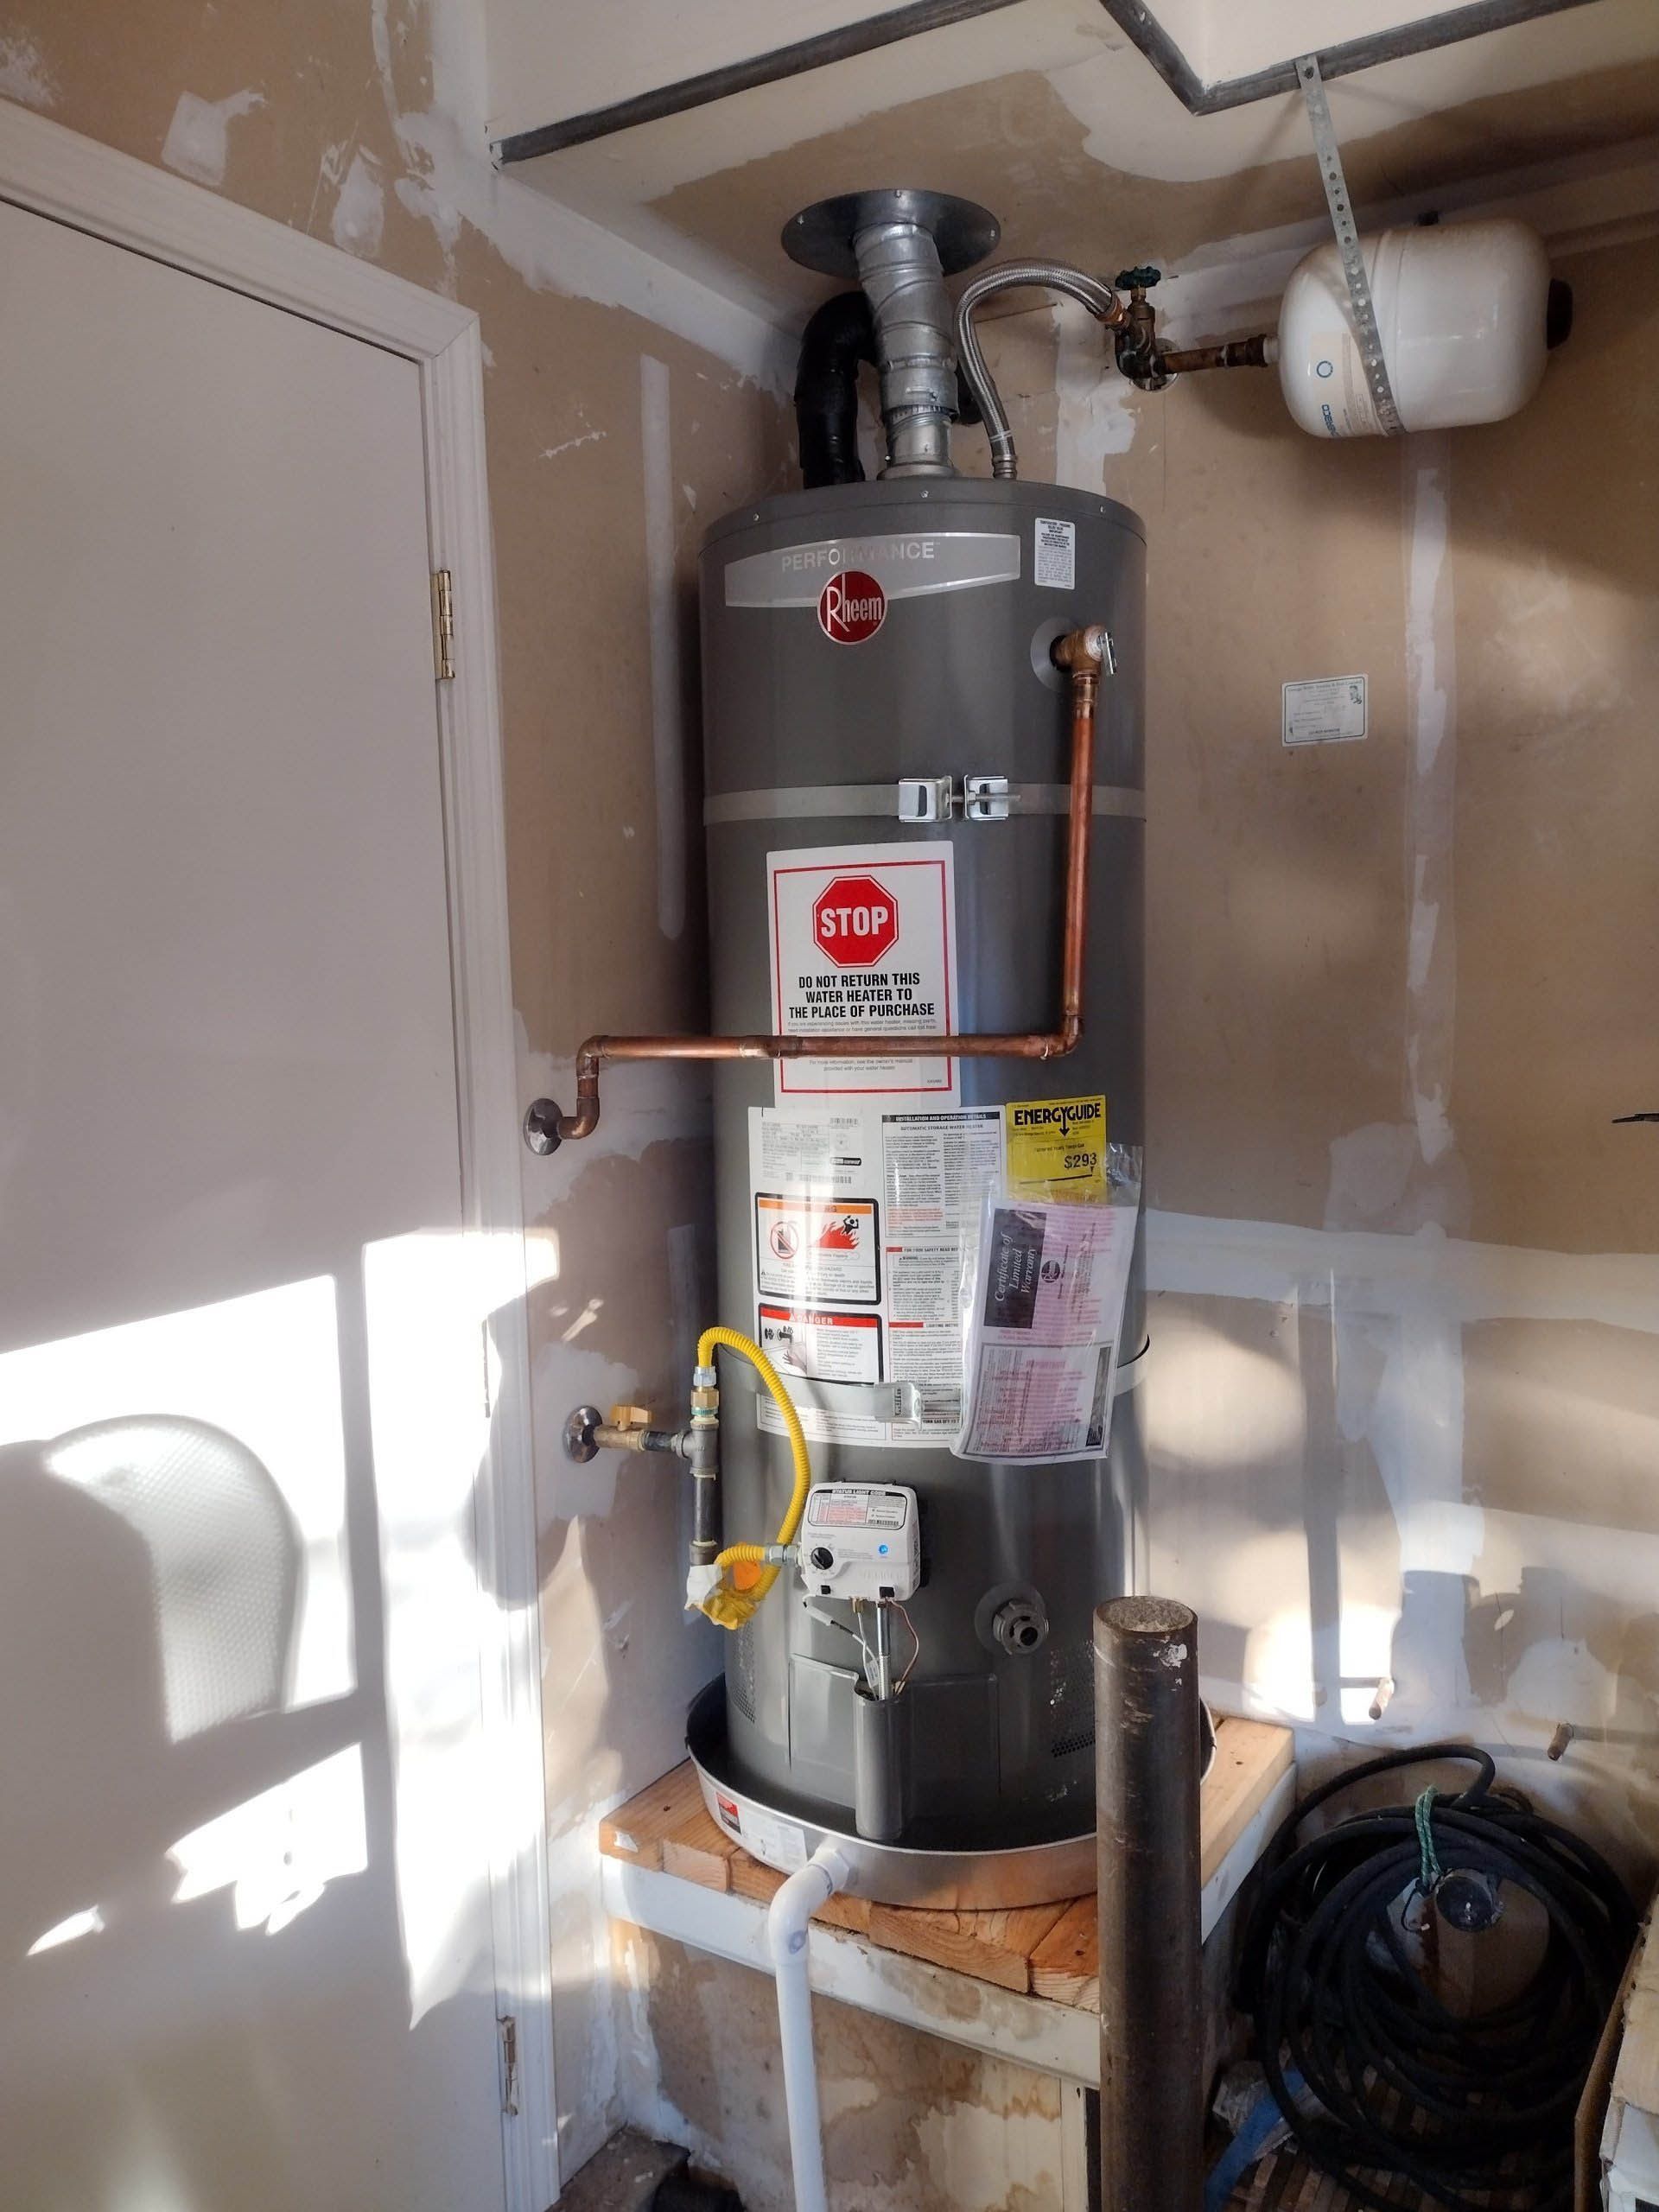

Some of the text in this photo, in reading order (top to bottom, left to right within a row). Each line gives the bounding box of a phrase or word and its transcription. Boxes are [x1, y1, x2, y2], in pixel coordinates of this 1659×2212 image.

[825, 573, 882, 632] Rheem
[821, 906, 888, 938] STOP
[799, 973, 920, 988] DO NOT RETURN THIS
[806, 988, 912, 1003] WATER HEATER TO
[789, 1003, 934, 1018] THE PLACE OF PURCHASE
[1014, 1103, 1101, 1126] ENERGYGUIDE
[1064, 1152, 1097, 1170] $293
[995, 1231, 1013, 1301] Certificate of
[1009, 1248, 1023, 1289] Limited
